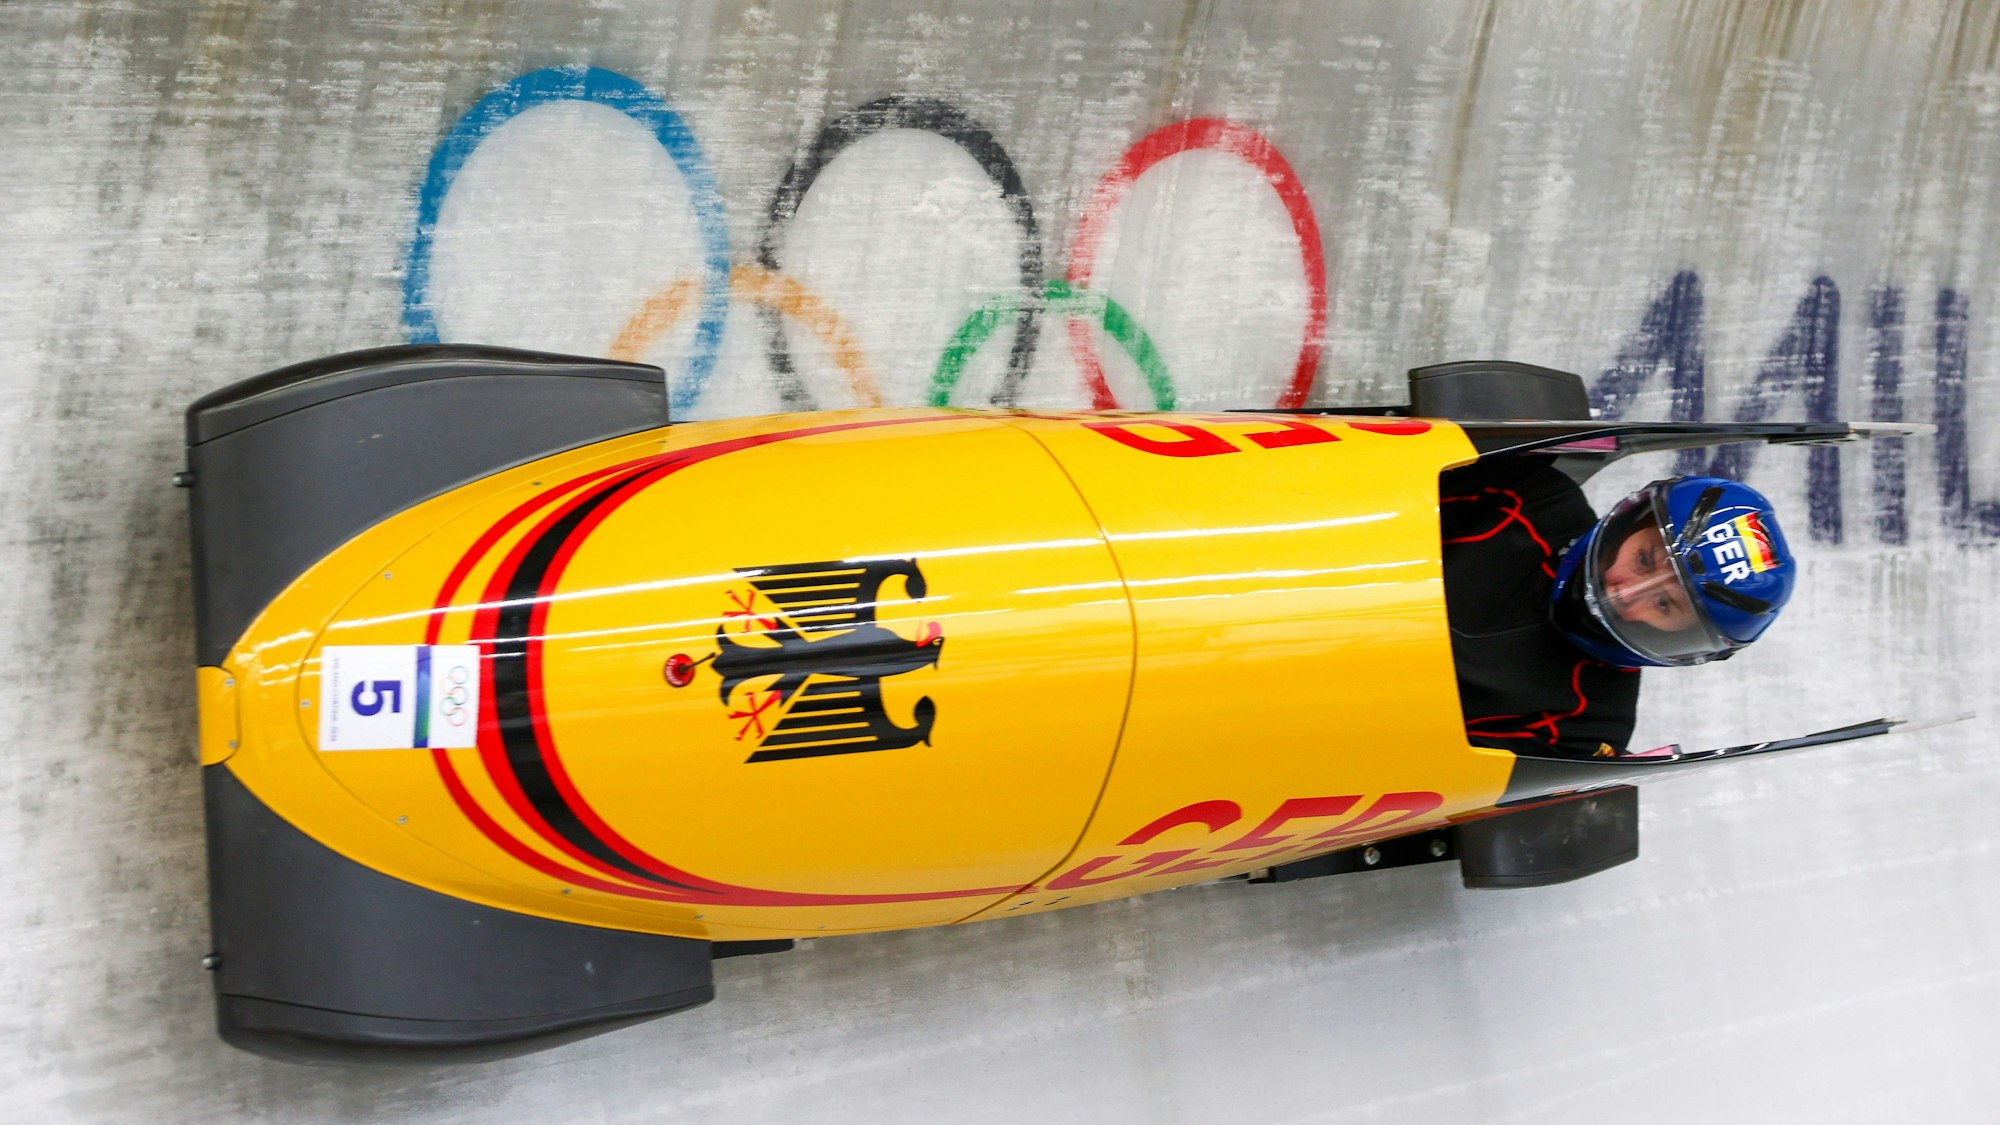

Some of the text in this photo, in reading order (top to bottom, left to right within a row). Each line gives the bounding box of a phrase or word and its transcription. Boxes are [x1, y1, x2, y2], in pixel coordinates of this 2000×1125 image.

[1706, 522, 1750, 585] GER
[351, 680, 401, 716] 5
[1045, 791, 1446, 891] GER
